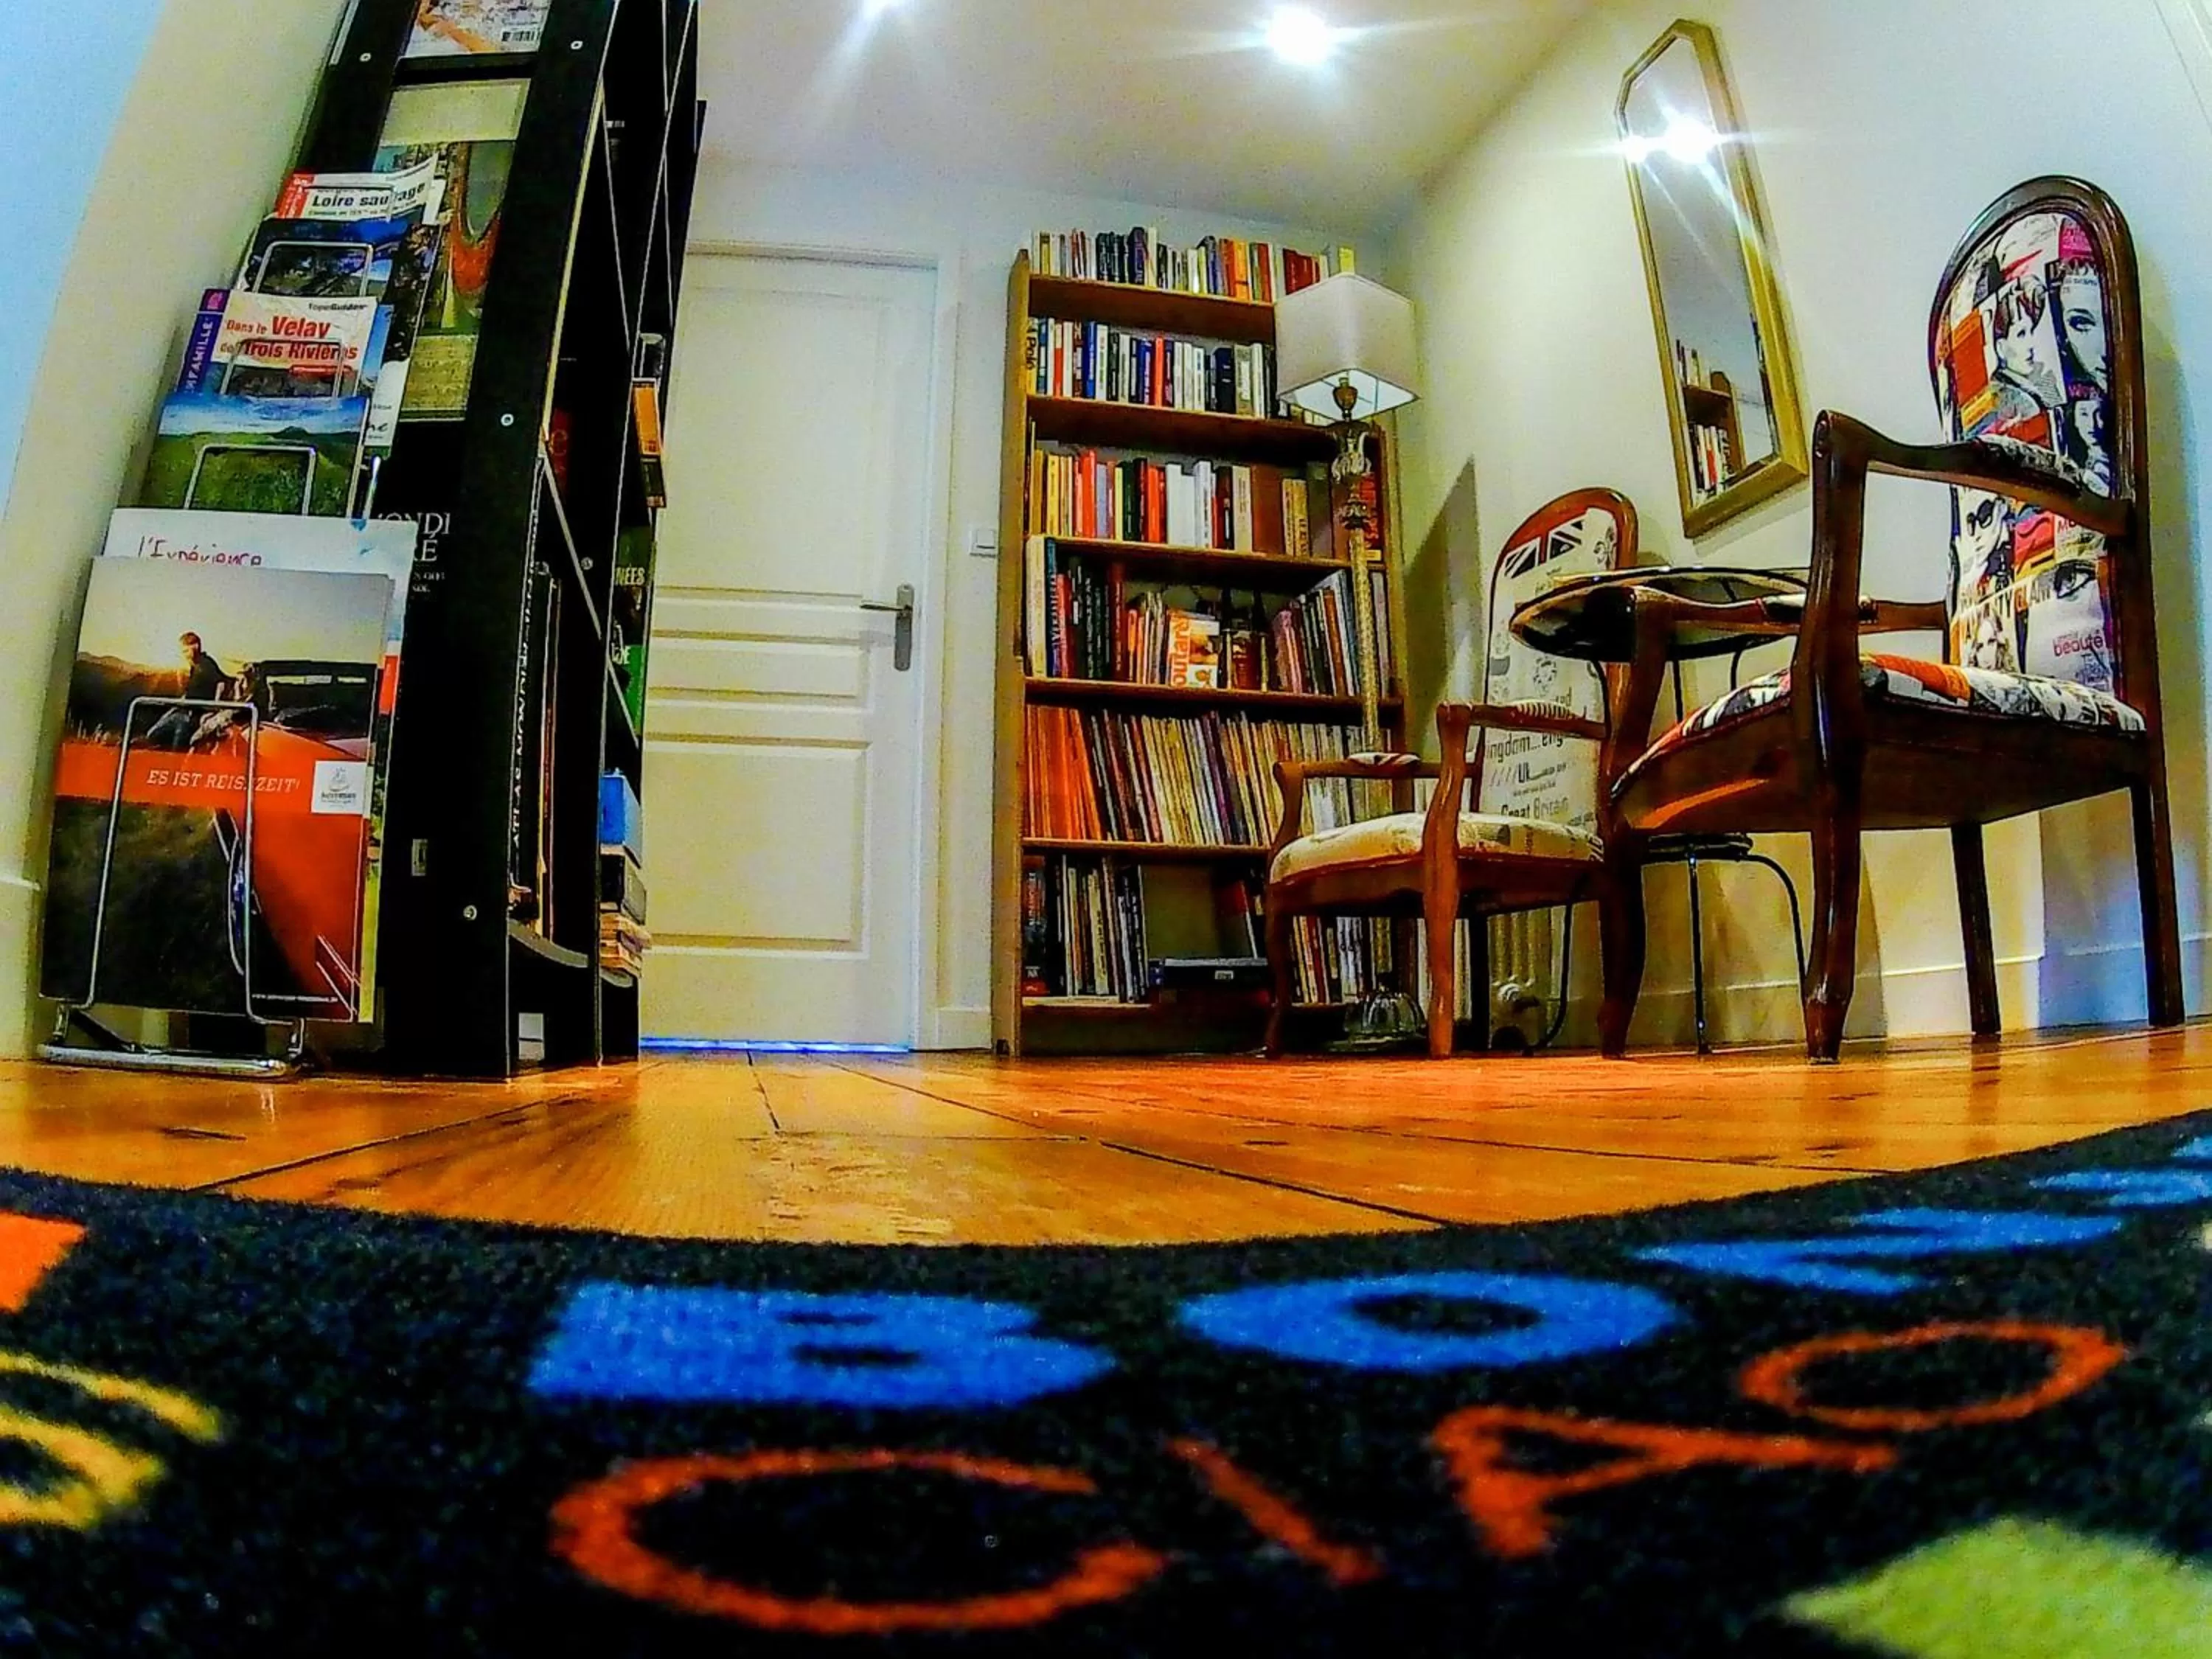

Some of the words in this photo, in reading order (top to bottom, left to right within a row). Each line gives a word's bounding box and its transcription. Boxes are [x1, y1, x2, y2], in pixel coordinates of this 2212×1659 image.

[312, 193, 354, 207] Loire
[359, 183, 425, 206] sauage
[272, 315, 330, 338] Velay
[2053, 629, 2103, 657] beauté
[147, 770, 169, 785] ES
[173, 772, 202, 787] IST
[549, 1320, 2127, 1634] CIAO
